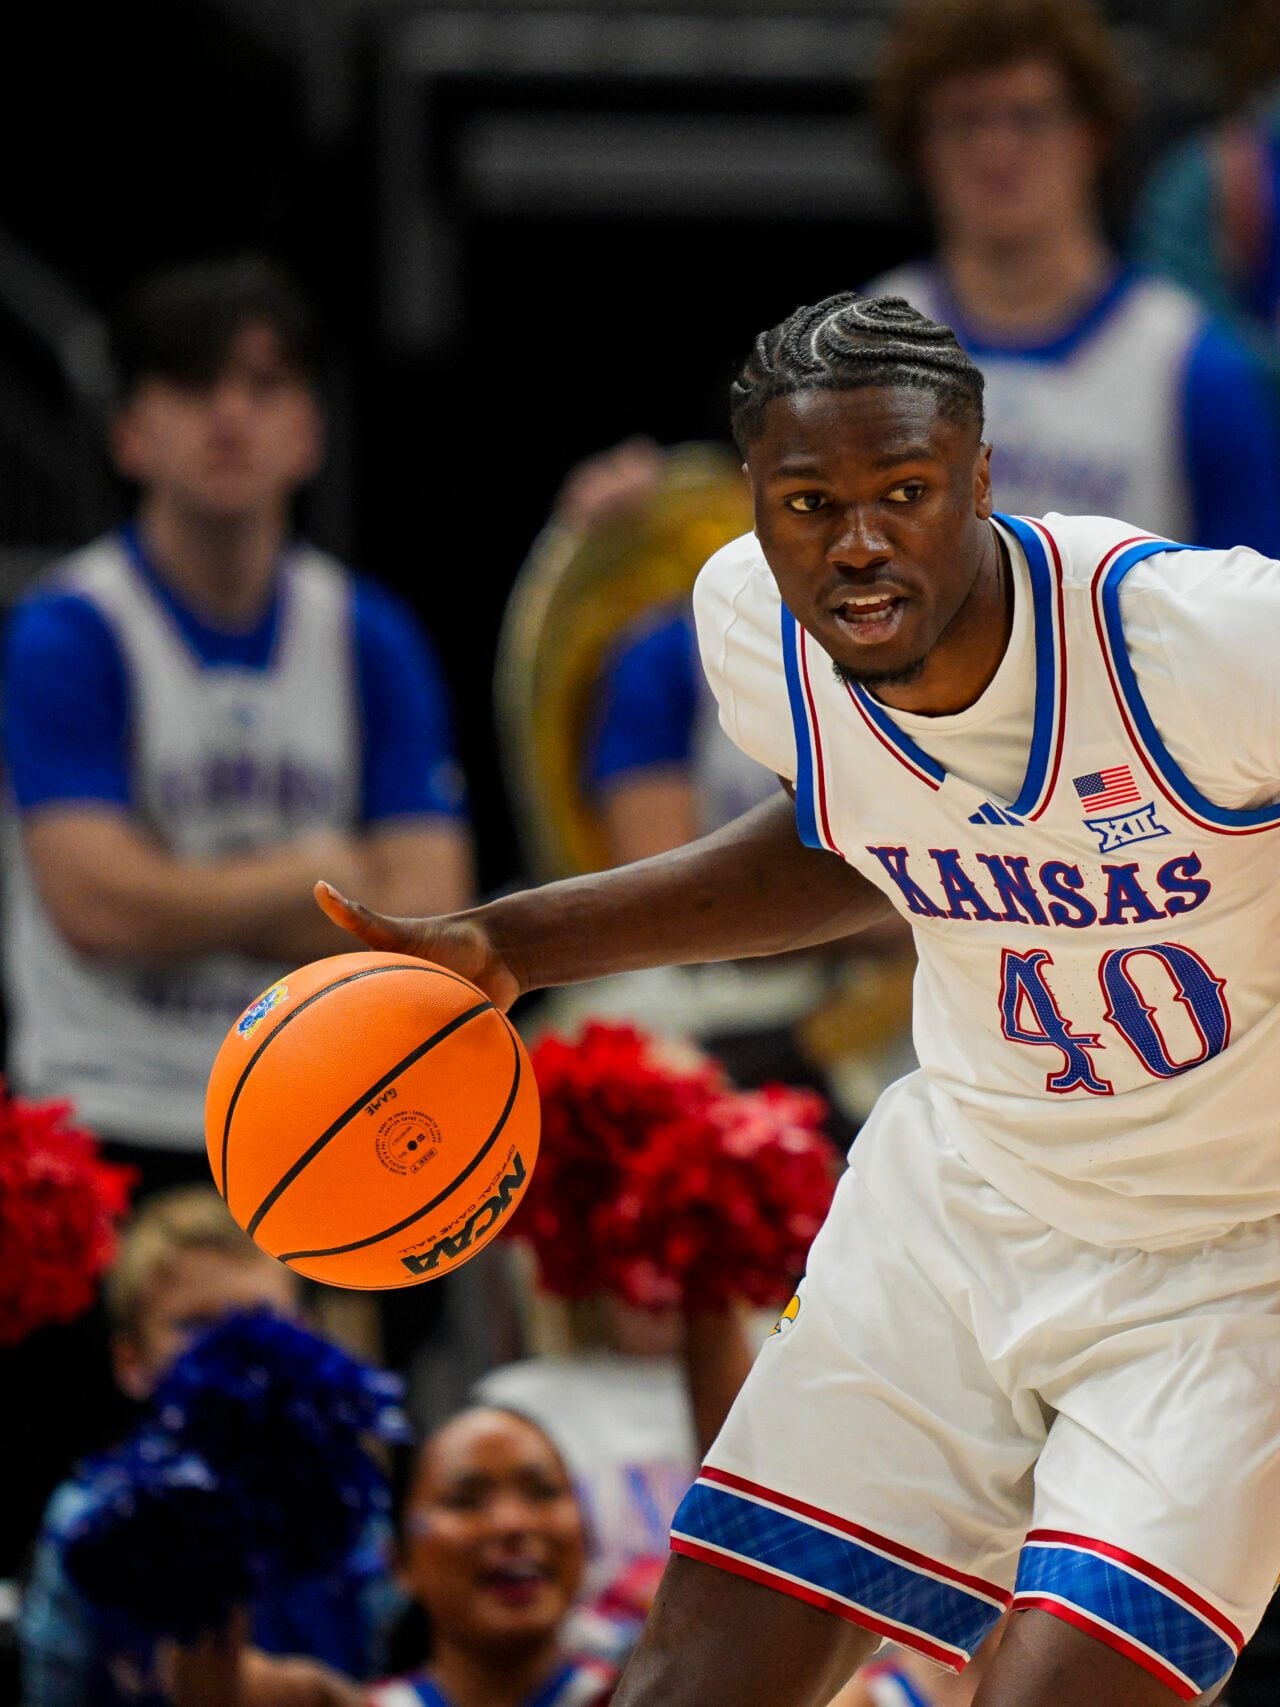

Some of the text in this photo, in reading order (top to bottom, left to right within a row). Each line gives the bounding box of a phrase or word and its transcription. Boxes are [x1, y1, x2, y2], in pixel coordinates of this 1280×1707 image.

[1082, 801, 1173, 854] XII
[865, 846, 1212, 929] KANSAS
[998, 941, 1232, 1096] 40
[364, 1088, 397, 1116] GAME
[398, 1144, 516, 1254] OFFICIAL GAME BALL
[400, 1151, 526, 1275] NCAA
